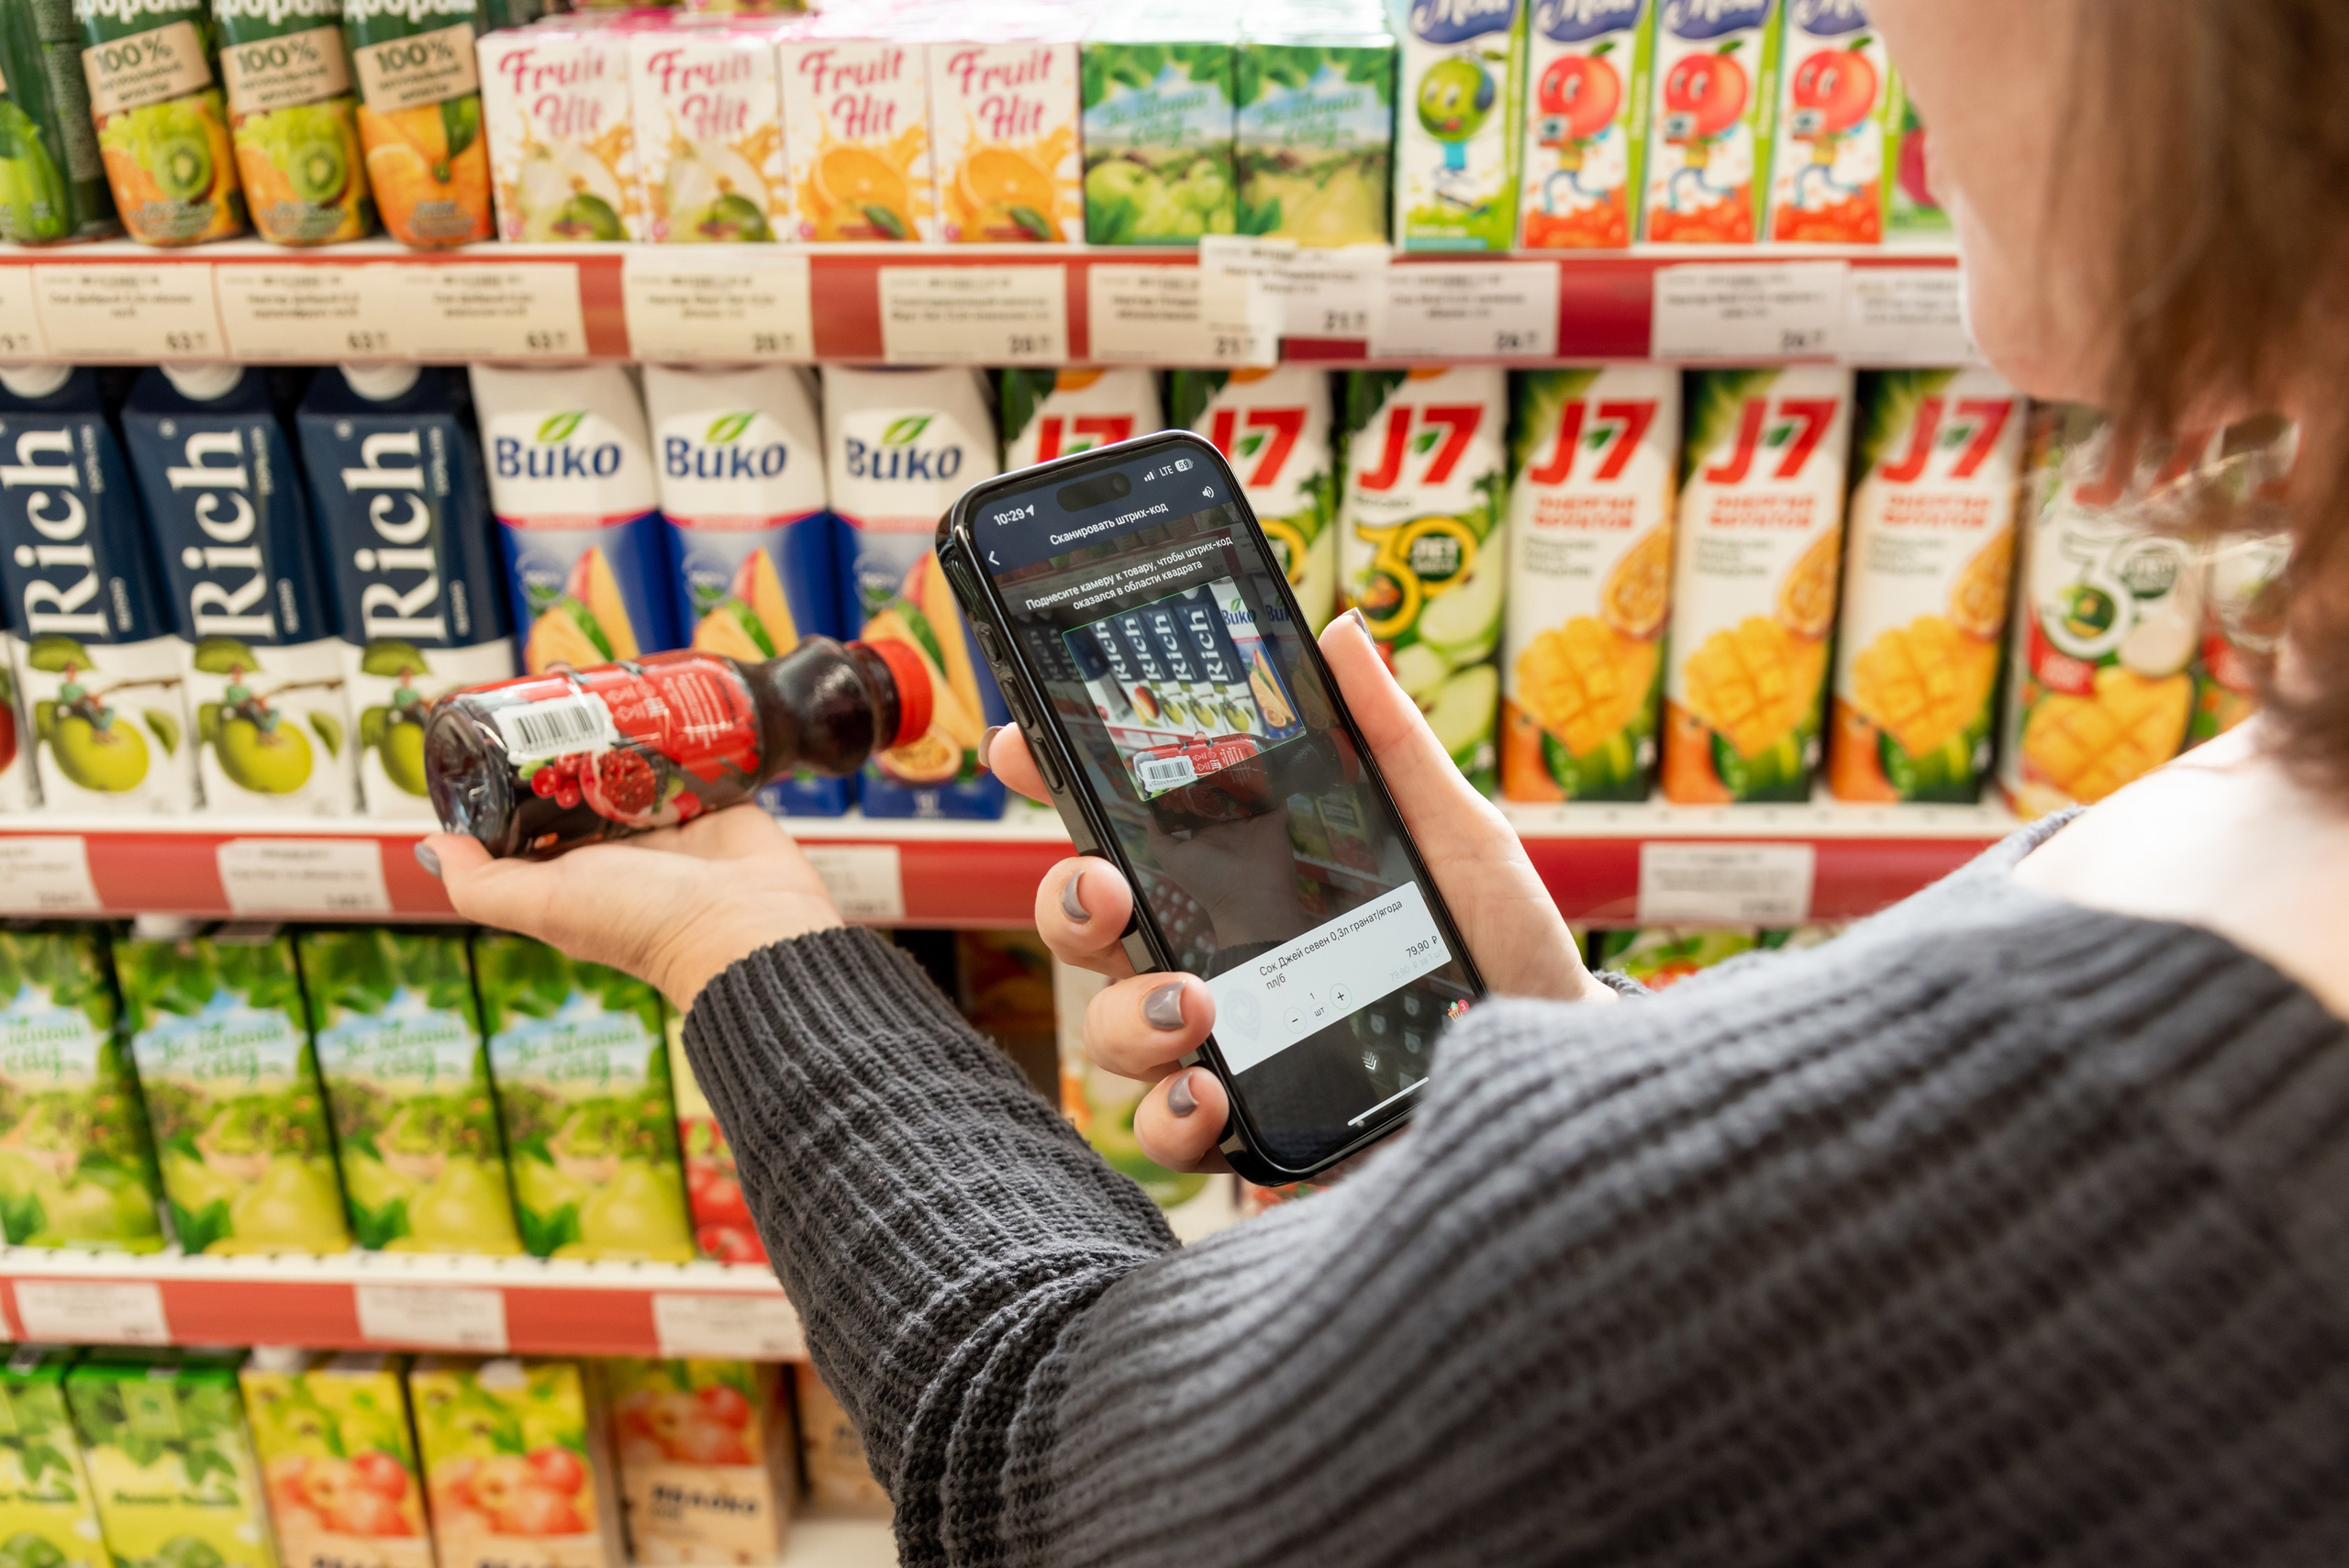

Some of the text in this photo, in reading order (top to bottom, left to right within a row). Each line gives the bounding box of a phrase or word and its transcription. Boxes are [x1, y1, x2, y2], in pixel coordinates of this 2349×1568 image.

[799, 48, 905, 93] Fruit
[948, 49, 1053, 94] Fruit
[832, 95, 898, 138] Hit
[979, 95, 1046, 138] Hit
[1359, 404, 1484, 491] J7
[1530, 398, 1659, 485] J7
[1704, 398, 1839, 484] J7
[1880, 398, 2016, 484] J7
[1159, 461, 1189, 476] LTE 59
[1, 425, 110, 638] Rich
[166, 425, 277, 639] Rich
[340, 426, 449, 641] Rich
[993, 507, 1026, 526] 10:29
[1049, 503, 1169, 545] Сканировать штрих-код
[1025, 536, 1233, 610] Поднесите камеру к товару, чтобы штрих-код
[1073, 561, 1203, 610] оказался в области квадрата
[1095, 621, 1132, 680] Rich
[1124, 617, 1163, 680] Rich
[1154, 614, 1193, 681] Rich
[1189, 609, 1230, 682] Rich
[1259, 900, 1403, 976] Сок Джей севен 0,3л гранат/ягода
[1405, 940, 1430, 958] 79,90
[1265, 973, 1286, 990] пл/б
[1309, 992, 1316, 1000] 1
[1388, 965, 1410, 982] 79,90
[1314, 1006, 1325, 1018] шт
